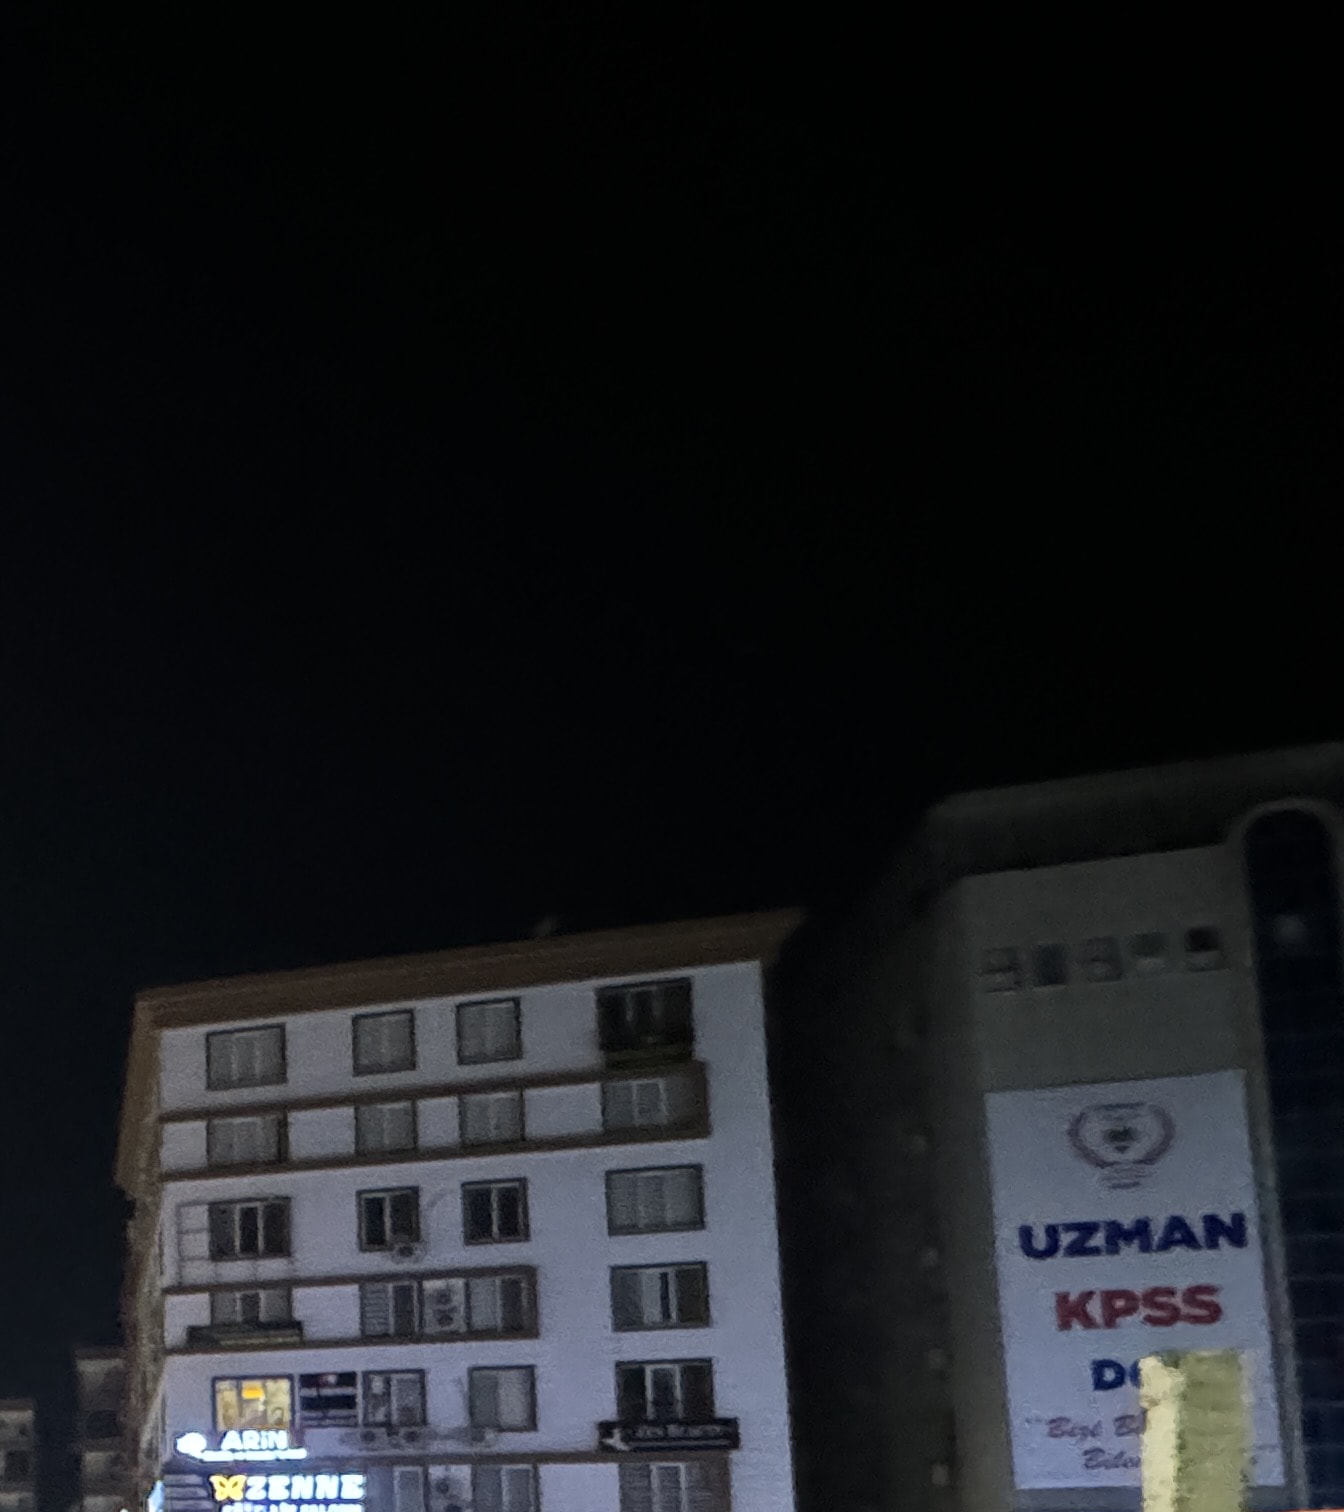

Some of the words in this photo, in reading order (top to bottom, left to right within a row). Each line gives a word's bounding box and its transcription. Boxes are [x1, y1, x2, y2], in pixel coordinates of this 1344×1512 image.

[1018, 1212, 1248, 1260] UZMAN
[1055, 1284, 1223, 1332] KPSS
[244, 1474, 367, 1501] ZENNE
